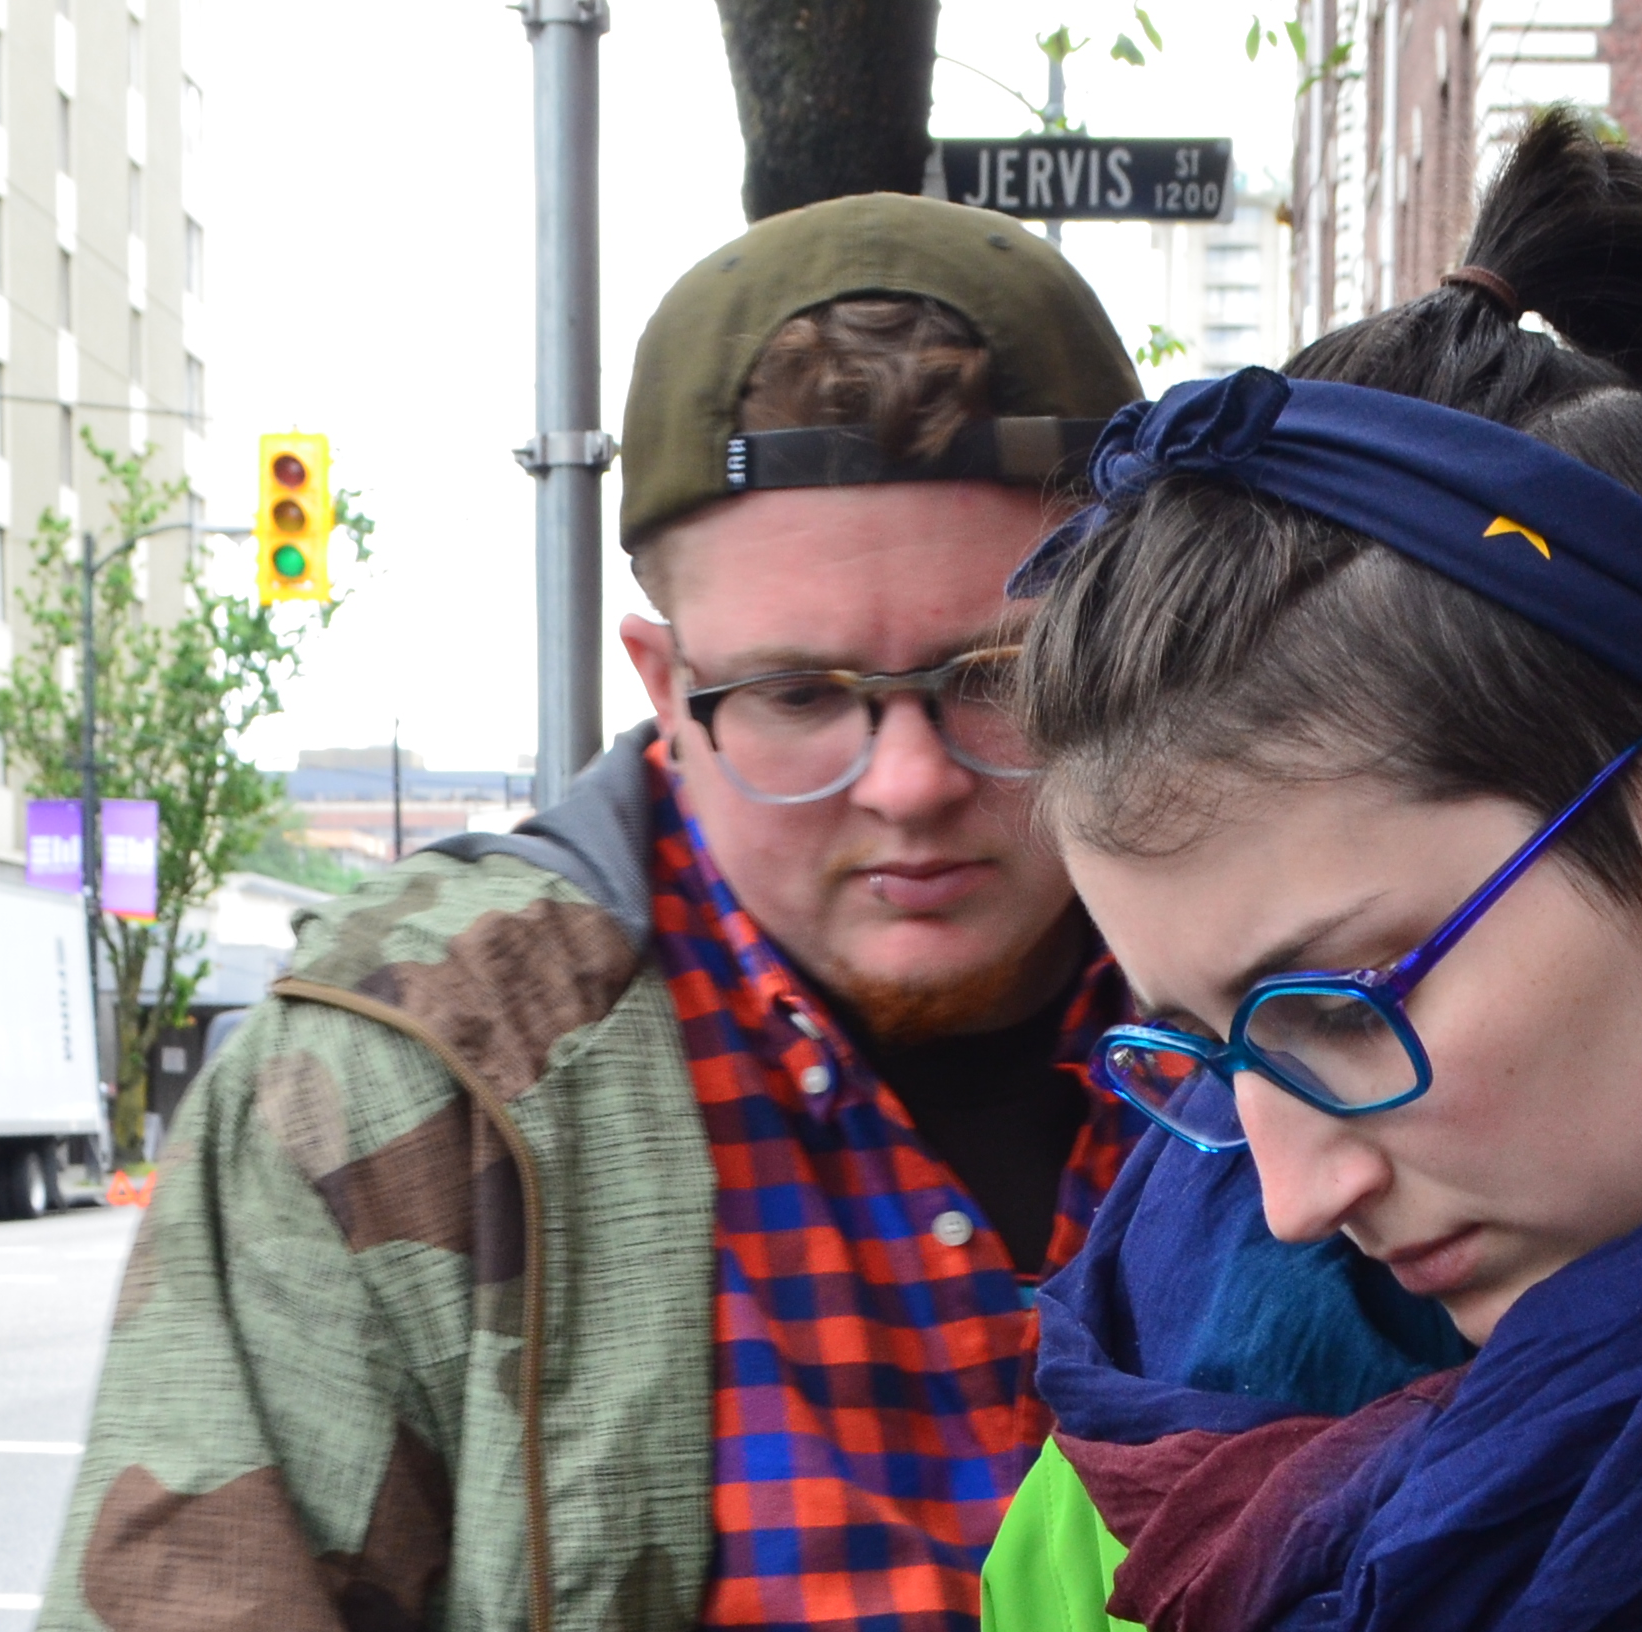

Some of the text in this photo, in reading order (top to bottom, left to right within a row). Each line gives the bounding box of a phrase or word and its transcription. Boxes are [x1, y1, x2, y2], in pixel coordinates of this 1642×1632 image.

[963, 147, 1201, 208] JERVIS ST
[1155, 181, 1219, 211] 1200
